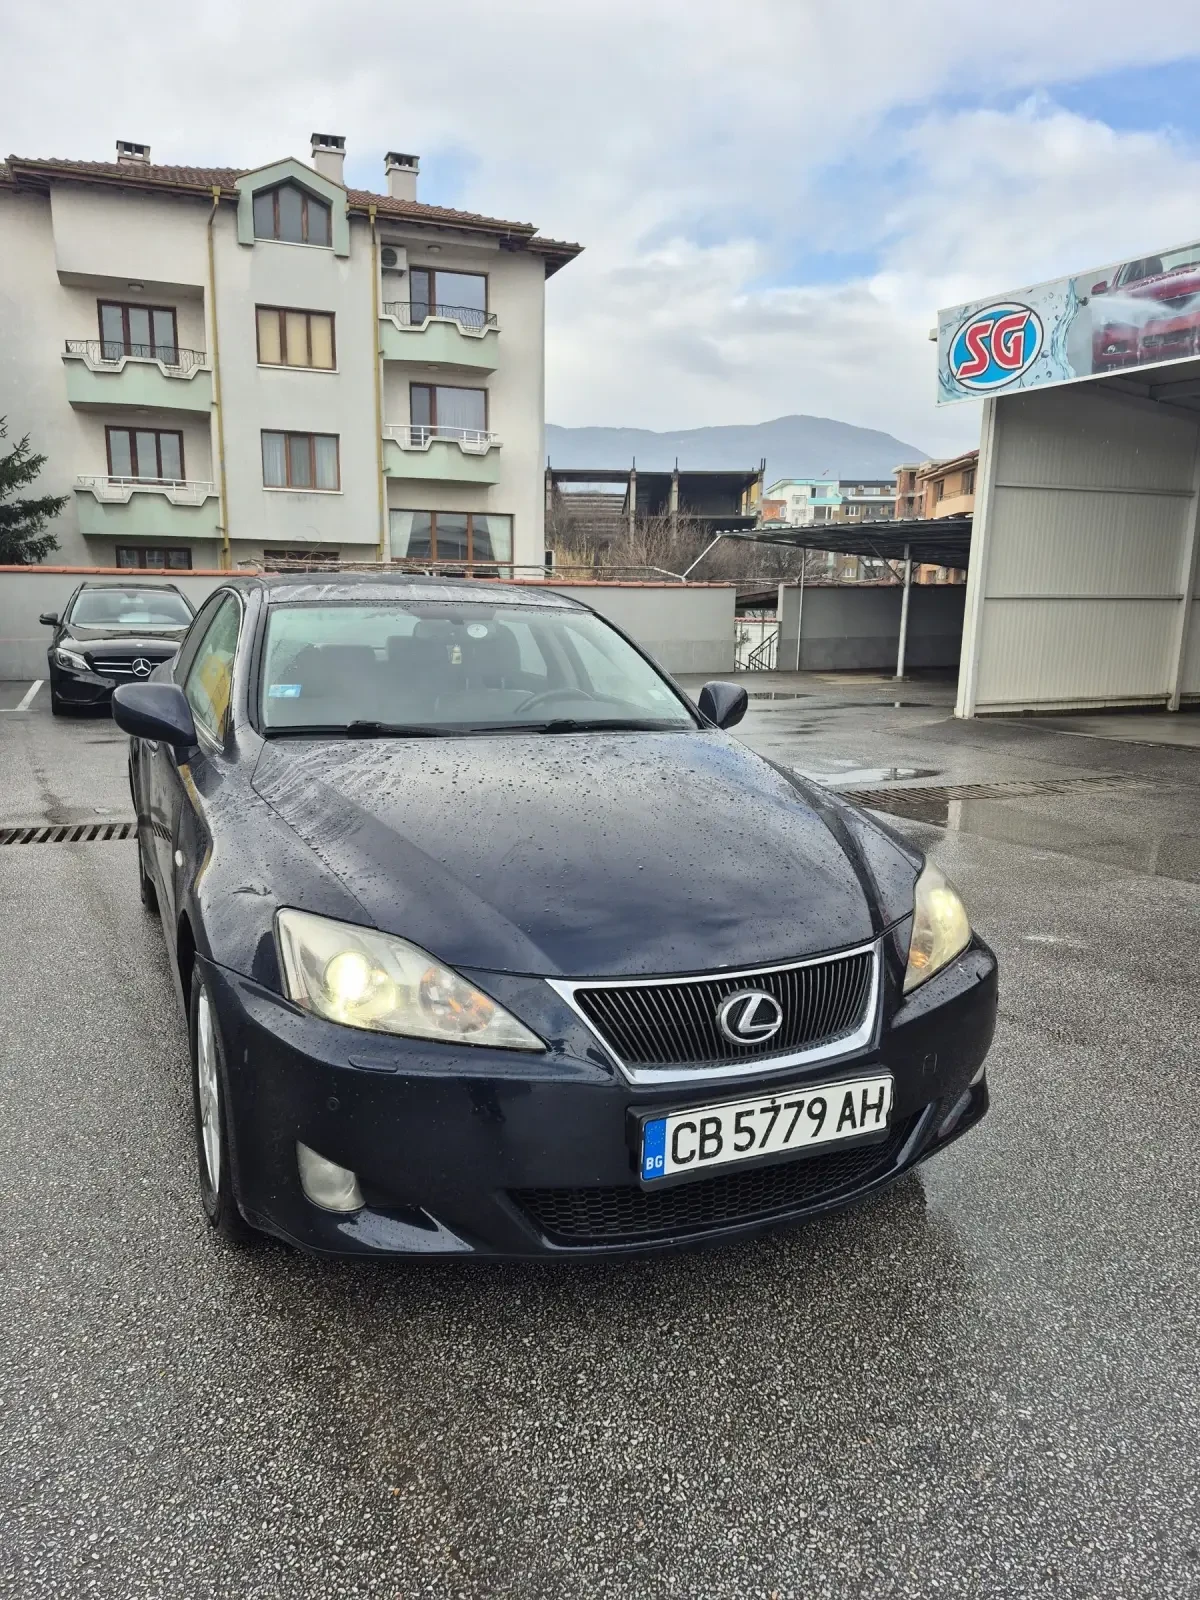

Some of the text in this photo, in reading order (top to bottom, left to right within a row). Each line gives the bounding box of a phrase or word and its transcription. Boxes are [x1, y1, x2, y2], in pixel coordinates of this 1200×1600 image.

[956, 310, 1031, 379] SG
[671, 1086, 885, 1165] CB 5779 AH
[645, 1155, 663, 1170] BG
